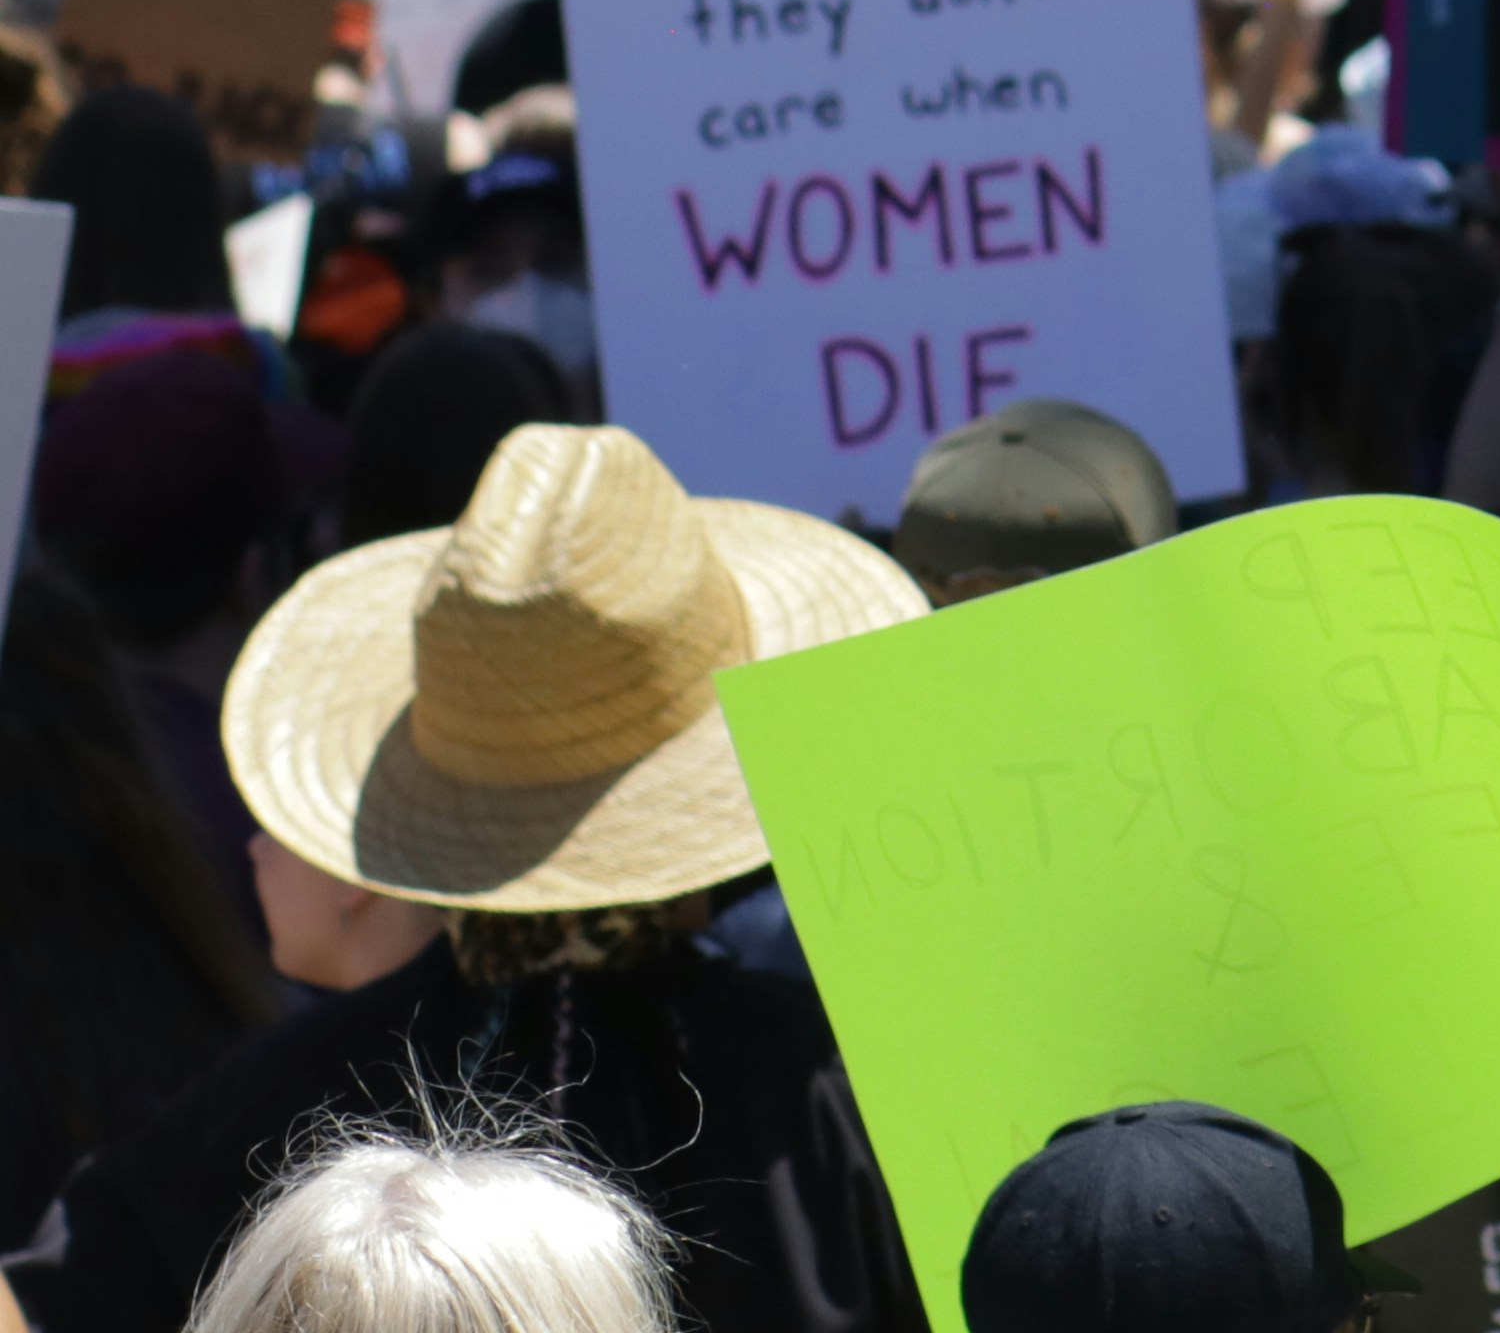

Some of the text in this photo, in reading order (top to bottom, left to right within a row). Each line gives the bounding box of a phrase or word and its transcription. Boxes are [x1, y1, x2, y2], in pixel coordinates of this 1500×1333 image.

[699, 67, 1068, 152] care when
[673, 146, 1108, 295] WOMEN
